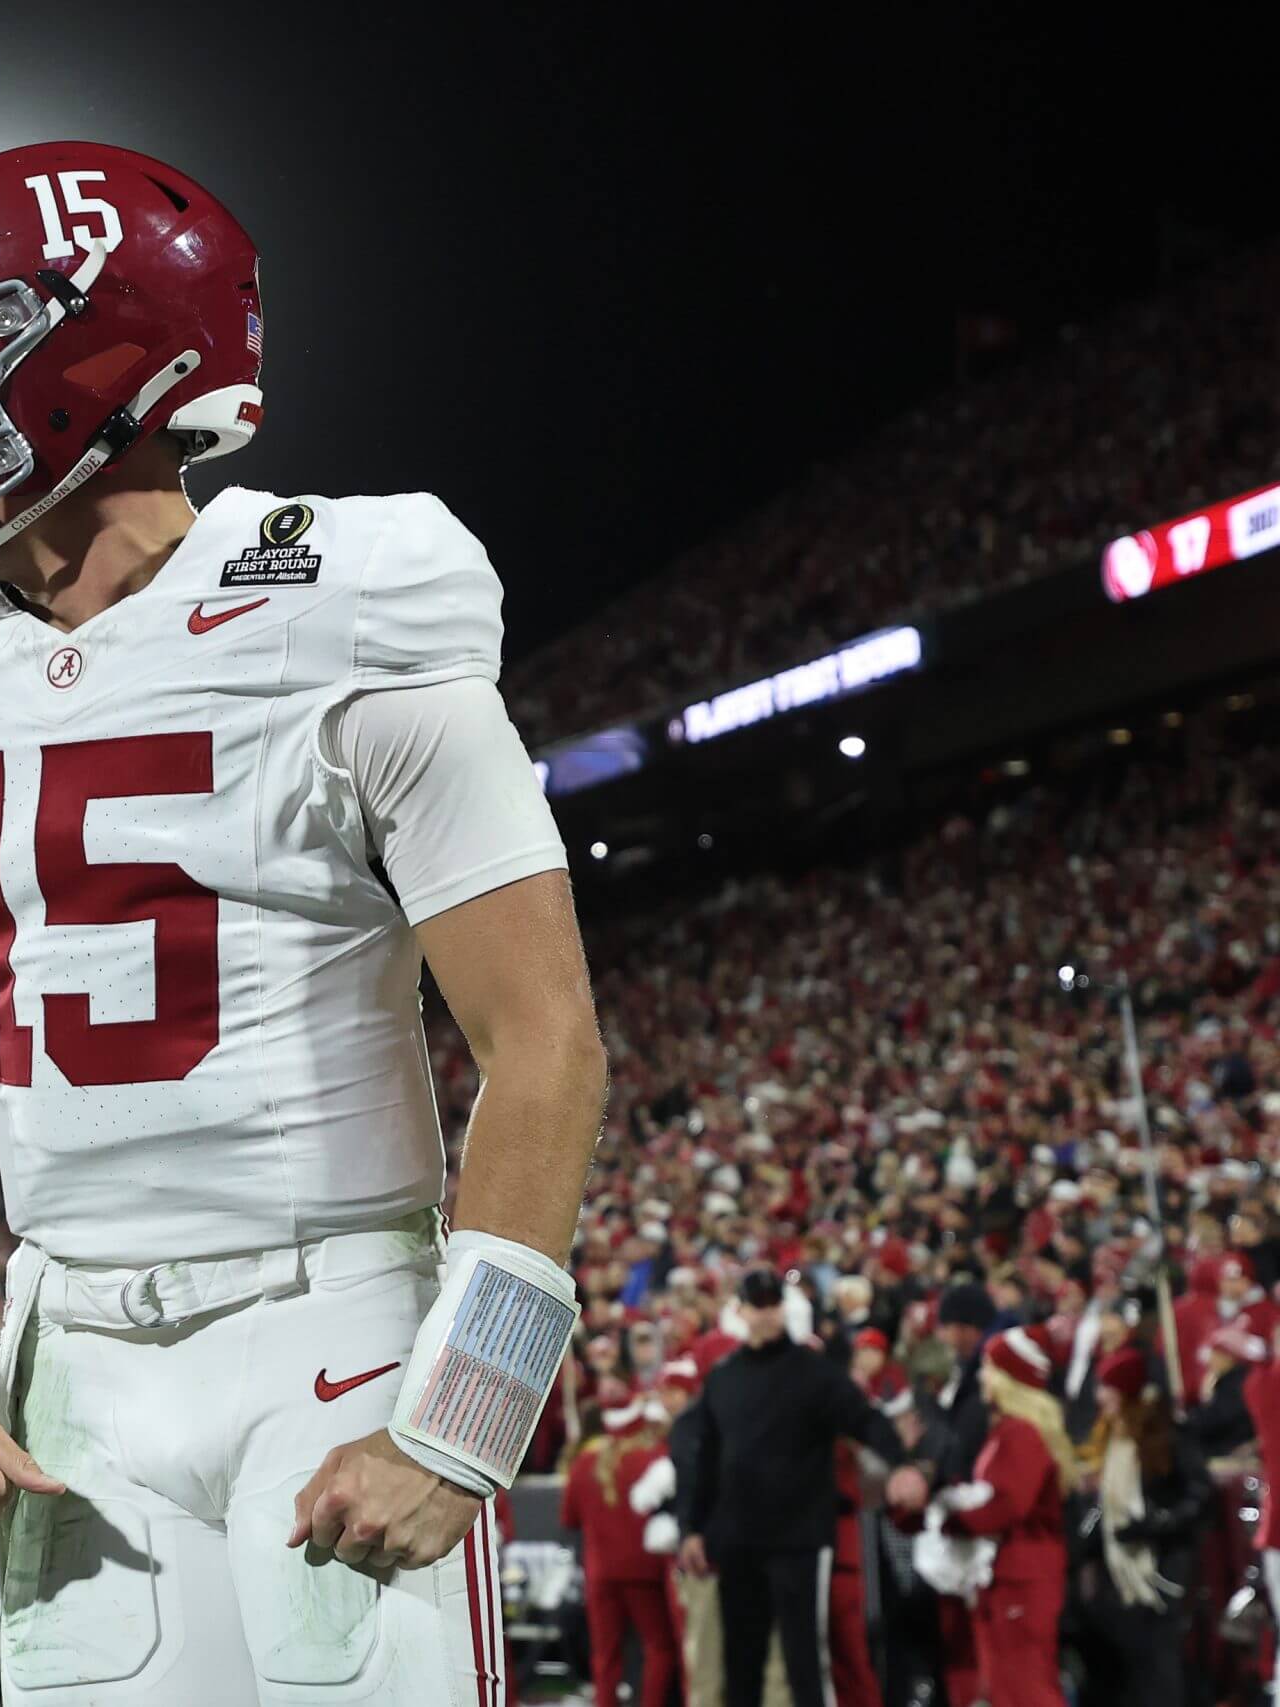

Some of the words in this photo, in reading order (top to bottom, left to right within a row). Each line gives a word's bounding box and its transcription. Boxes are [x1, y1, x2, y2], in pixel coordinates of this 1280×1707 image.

[24, 170, 124, 260] 15
[11, 484, 71, 531] CRIMSON
[71, 455, 101, 484] TIDE
[243, 547, 306, 560] PLAYOFF
[226, 560, 268, 573] FIRST
[269, 557, 318, 570] ROUND
[276, 571, 307, 580] Allstate
